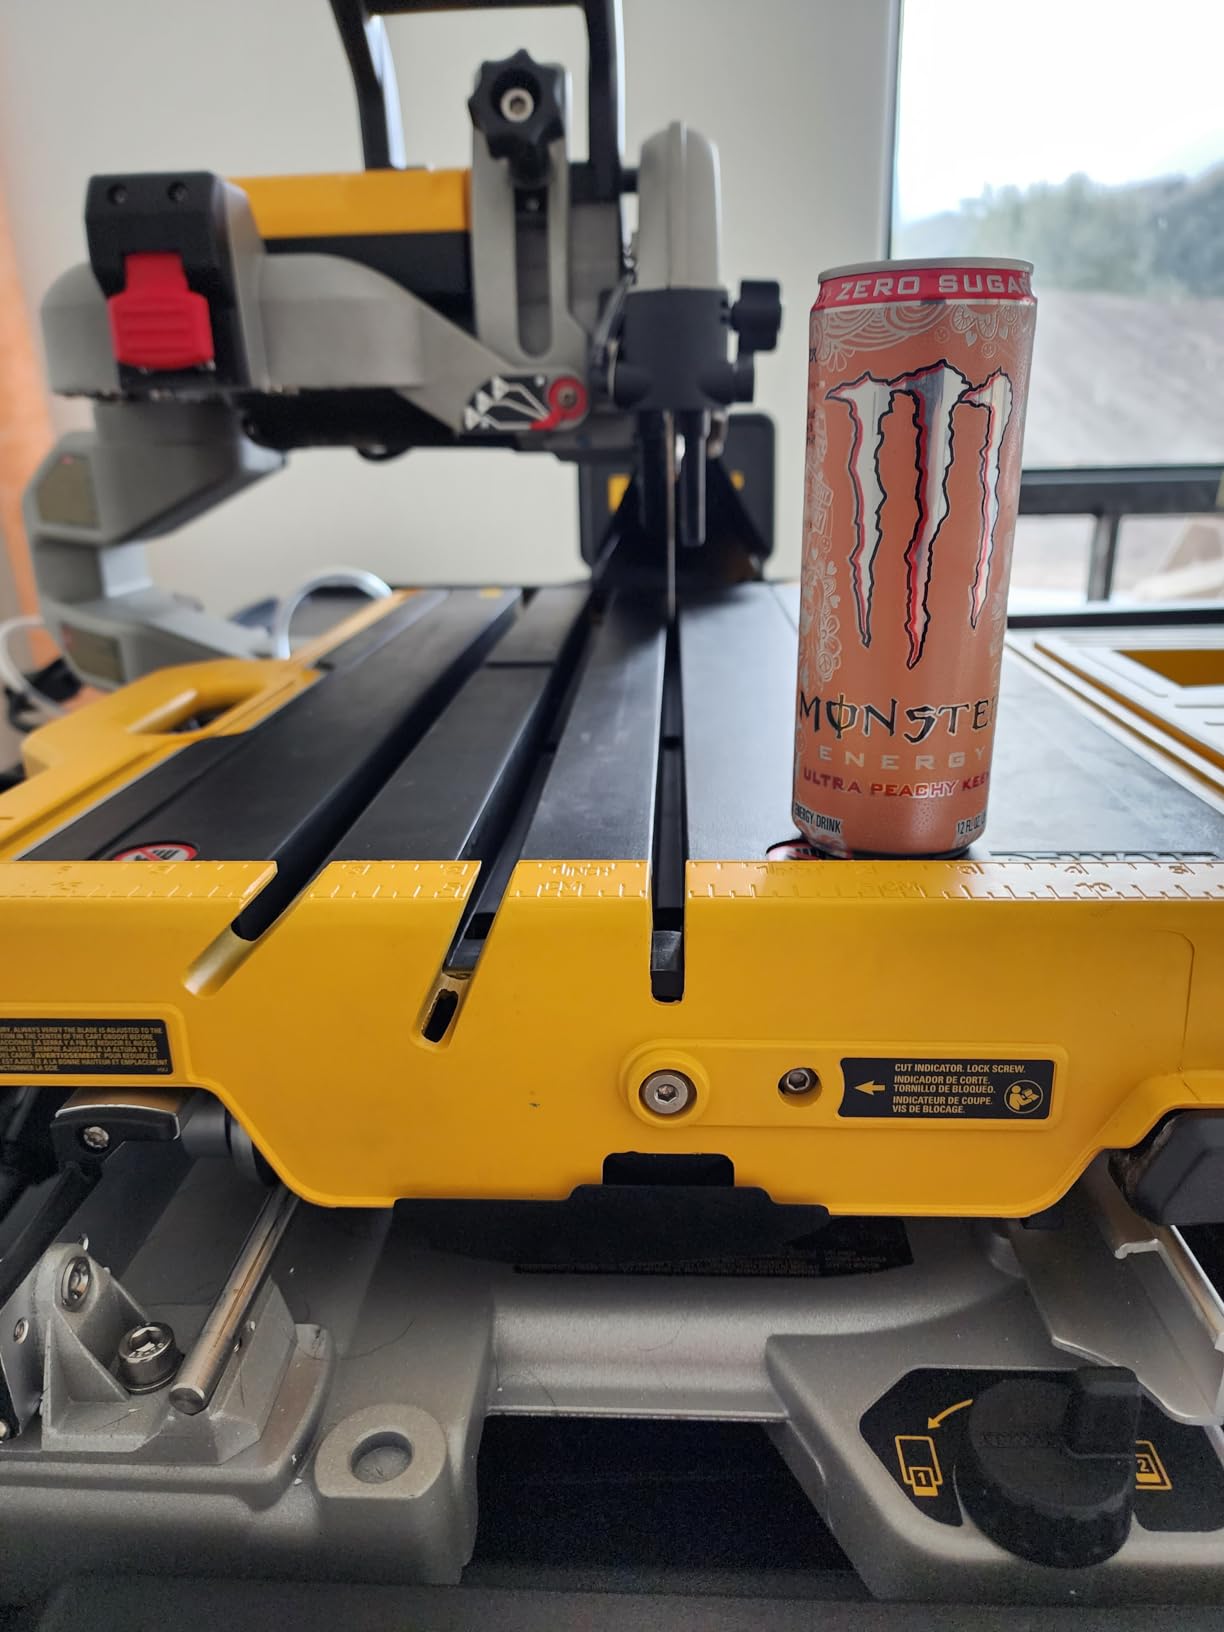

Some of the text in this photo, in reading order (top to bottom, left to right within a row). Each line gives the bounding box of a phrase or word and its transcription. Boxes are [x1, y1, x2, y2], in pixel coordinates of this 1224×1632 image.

[835, 275, 920, 301] ZERO
[799, 690, 996, 744] MONSTE
[819, 744, 986, 771] ENERGY
[803, 767, 862, 794] ULTRA
[870, 780, 960, 799] PEACHY
[815, 814, 841, 834] DRINK
[895, 1063, 1026, 1074] CUT INDICATOR. LOCK SCREW.
[894, 1075, 991, 1085] INDICADOR DE CORTE.
[893, 1084, 996, 1094] TORNILLO DE BLOQUEO.
[893, 1095, 993, 1105] INDICATEUR DE COUPE.
[892, 1104, 966, 1114] VIS DE BLOCAGE.
[1137, 1458, 1150, 1473] 2
[917, 1471, 927, 1486] 1
